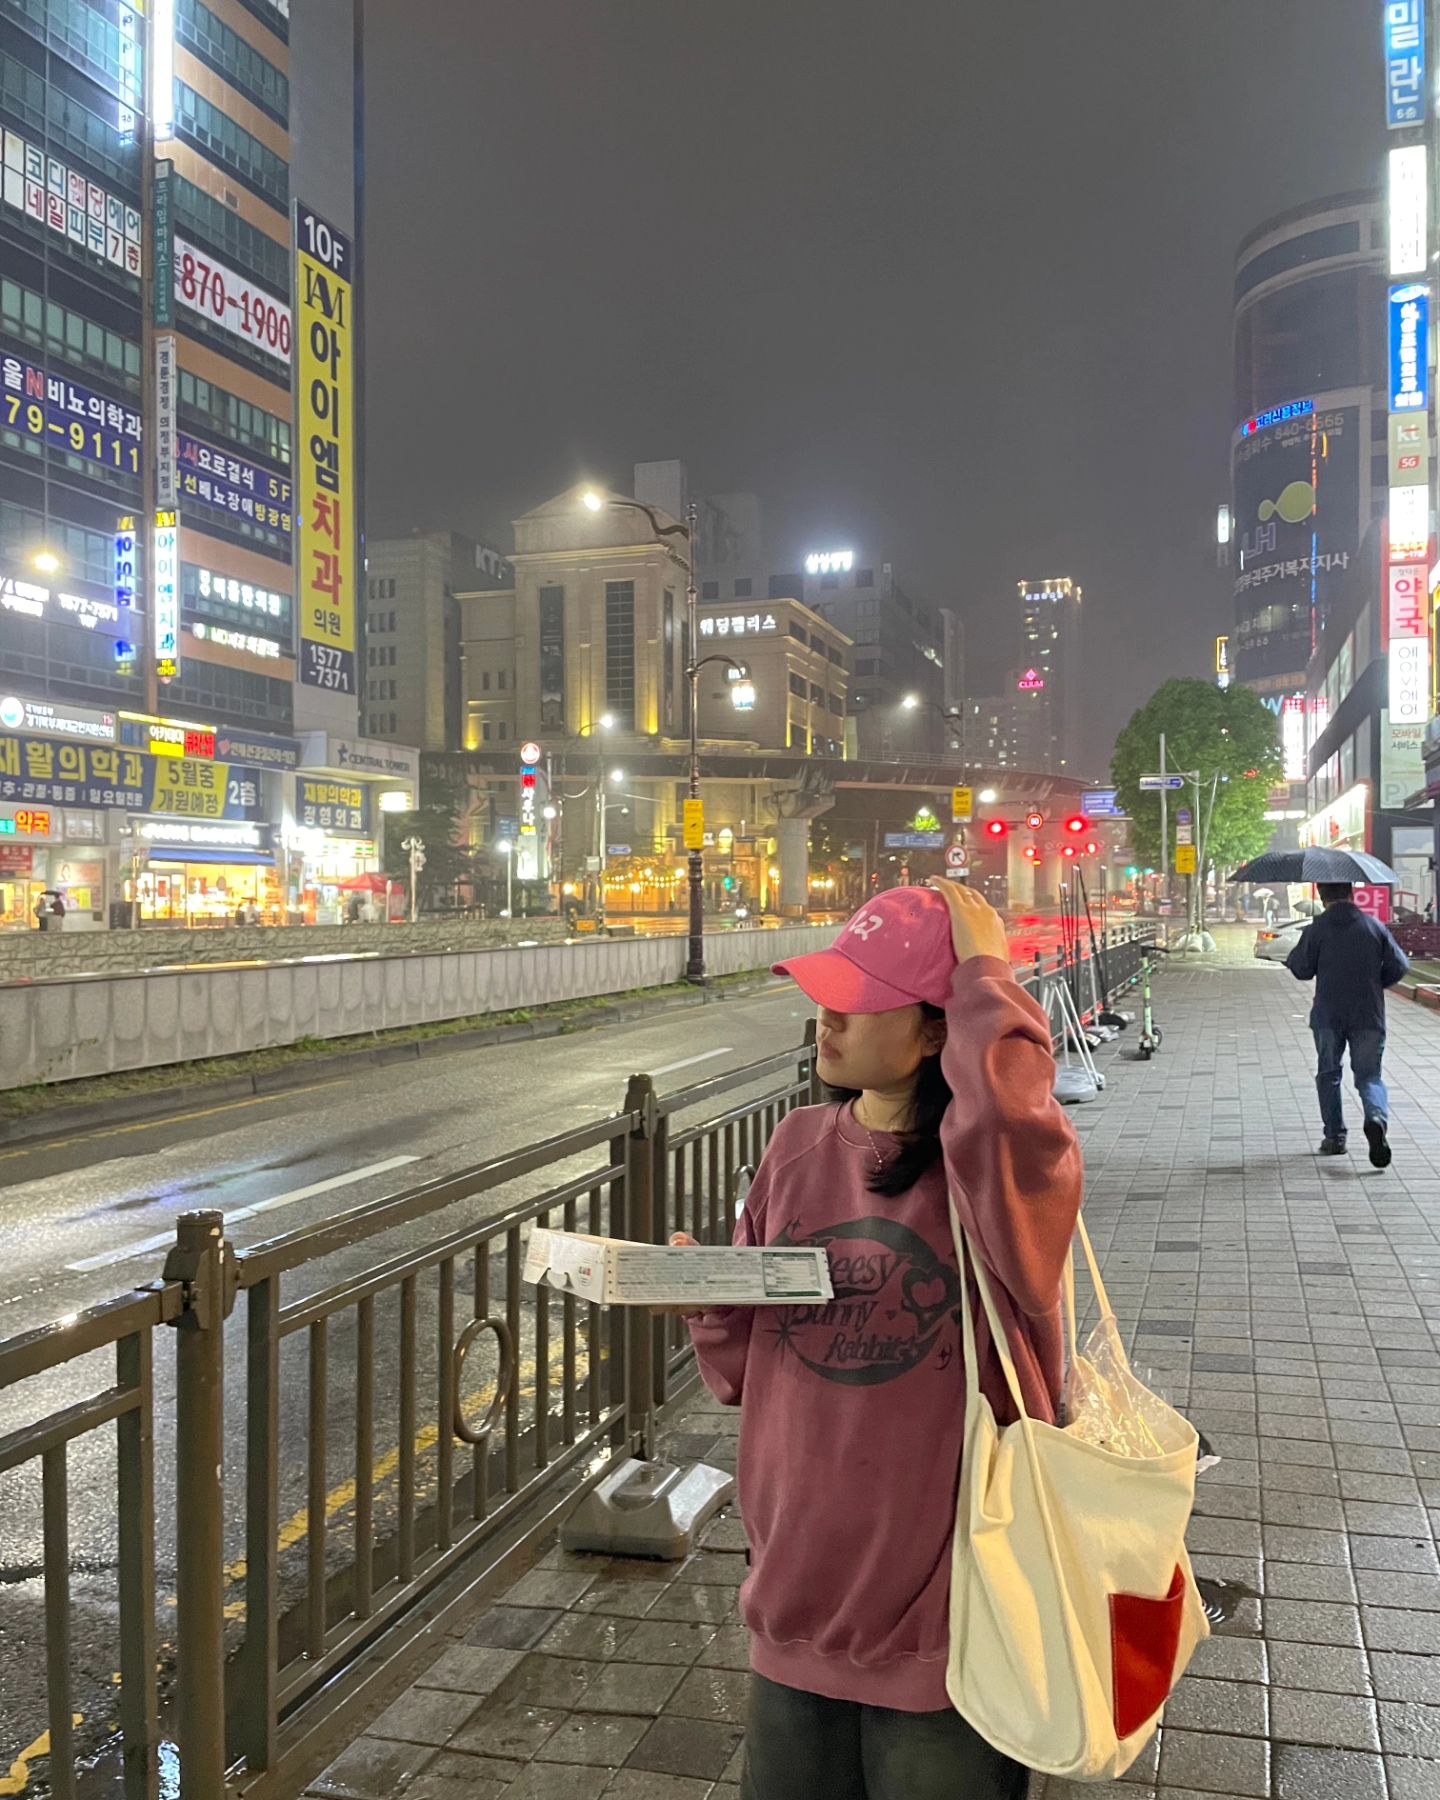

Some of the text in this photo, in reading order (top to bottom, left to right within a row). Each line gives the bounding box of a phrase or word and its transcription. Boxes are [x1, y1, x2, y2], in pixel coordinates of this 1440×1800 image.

[305, 215, 345, 269] 10F
[181, 253, 291, 355] 870-1900
[1394, 577, 1423, 635] 약국
[313, 608, 341, 637] 의원
[310, 645, 342, 669] 1577
[309, 664, 348, 690] -7371
[0, 737, 144, 787] 재활의학과
[228, 780, 256, 807] 2층
[15, 809, 51, 837] 약국
[303, 805, 363, 830] 정형외과
